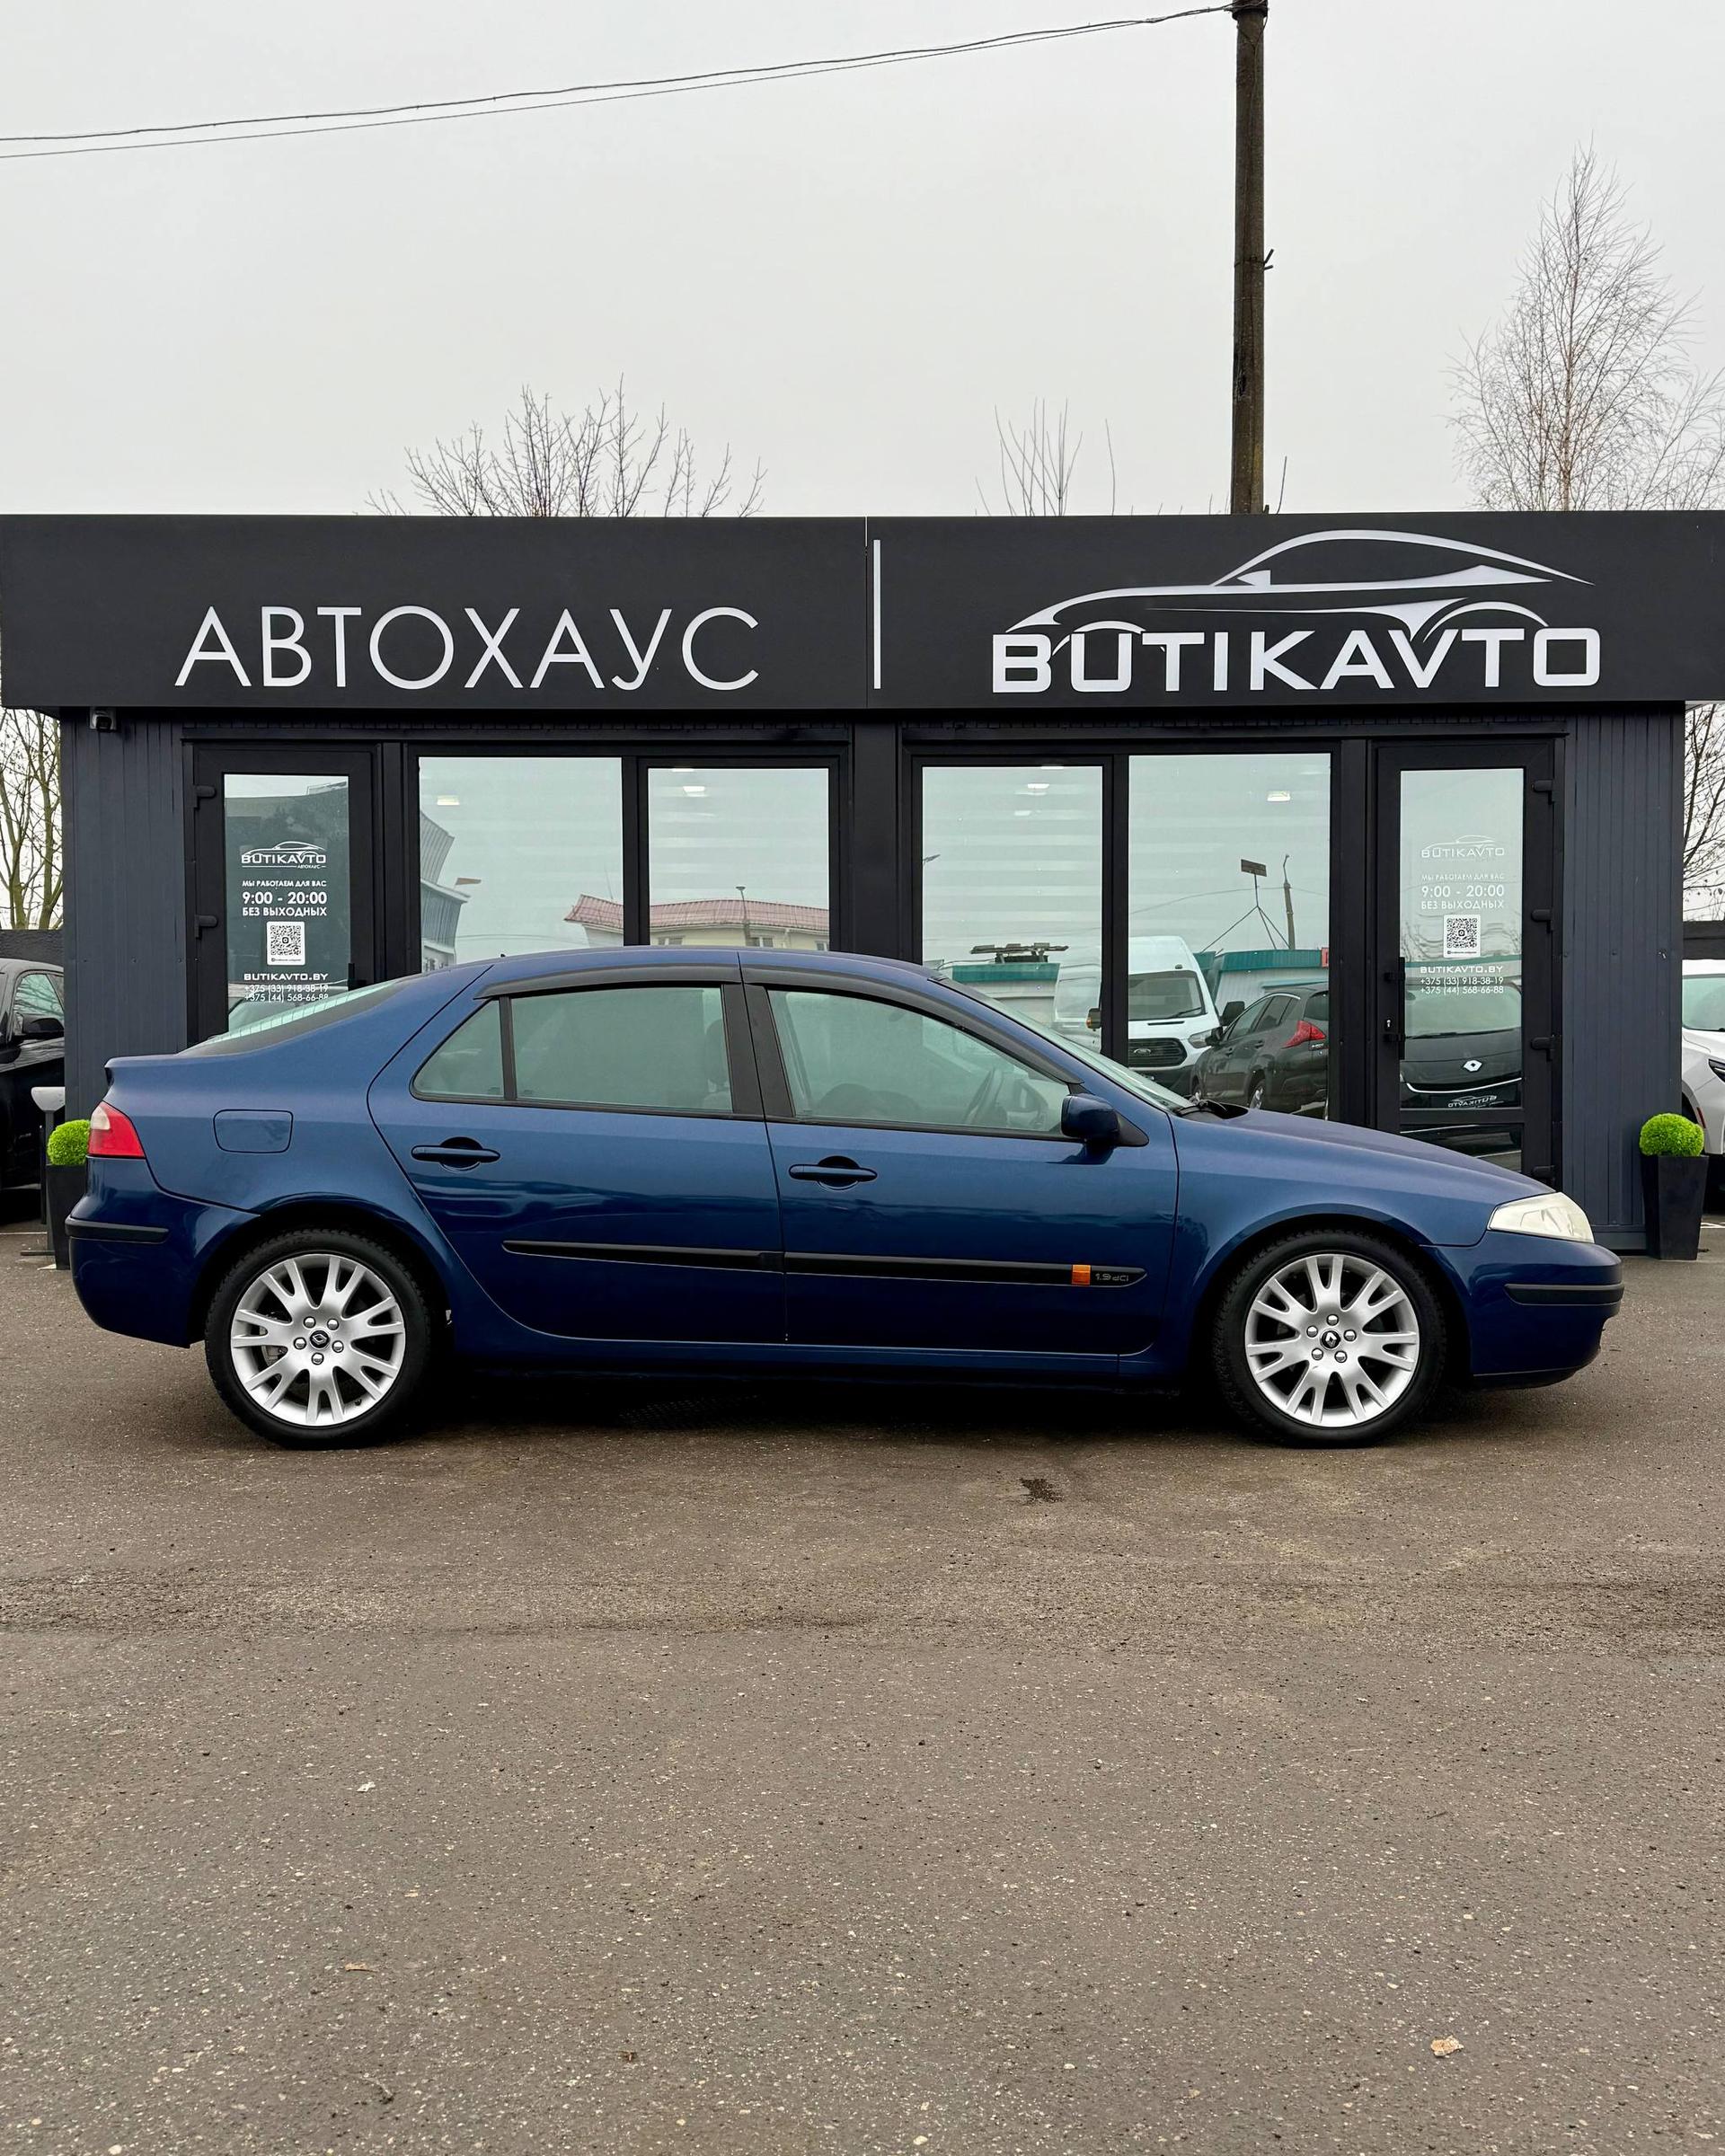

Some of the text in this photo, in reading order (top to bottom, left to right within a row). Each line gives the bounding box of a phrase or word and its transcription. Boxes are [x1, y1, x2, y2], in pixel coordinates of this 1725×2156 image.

[174, 605, 759, 690] АВТОХАУС
[992, 627, 1600, 694] BUTIKAVTO
[1421, 847, 1505, 858] BUTIKAVTO
[241, 854, 326, 863] BUTIKAVTO
[1421, 886, 1450, 897] 9:00
[1466, 884, 1505, 897] 20:00
[242, 891, 272, 905] 9:00
[288, 891, 327, 905] 20:00
[1421, 899, 1505, 910] БЕЗ ВЫХОДНЫХ
[242, 907, 327, 917] БЕЗ ВЫХОДНЫХ
[1420, 966, 1503, 974] BUTIKAVTO.BY
[243, 973, 329, 981] BUTIKAVTO.BY
[1420, 976, 1504, 986] +375 (33) 918-38-19
[244, 985, 266, 993] +375
[268, 984, 284, 994] (33)
[1420, 985, 1504, 995] +375 (44) 568-66-88
[244, 993, 266, 1002] +375
[268, 993, 284, 1003] (44)
[1095, 1273, 1111, 1281] 1.9
